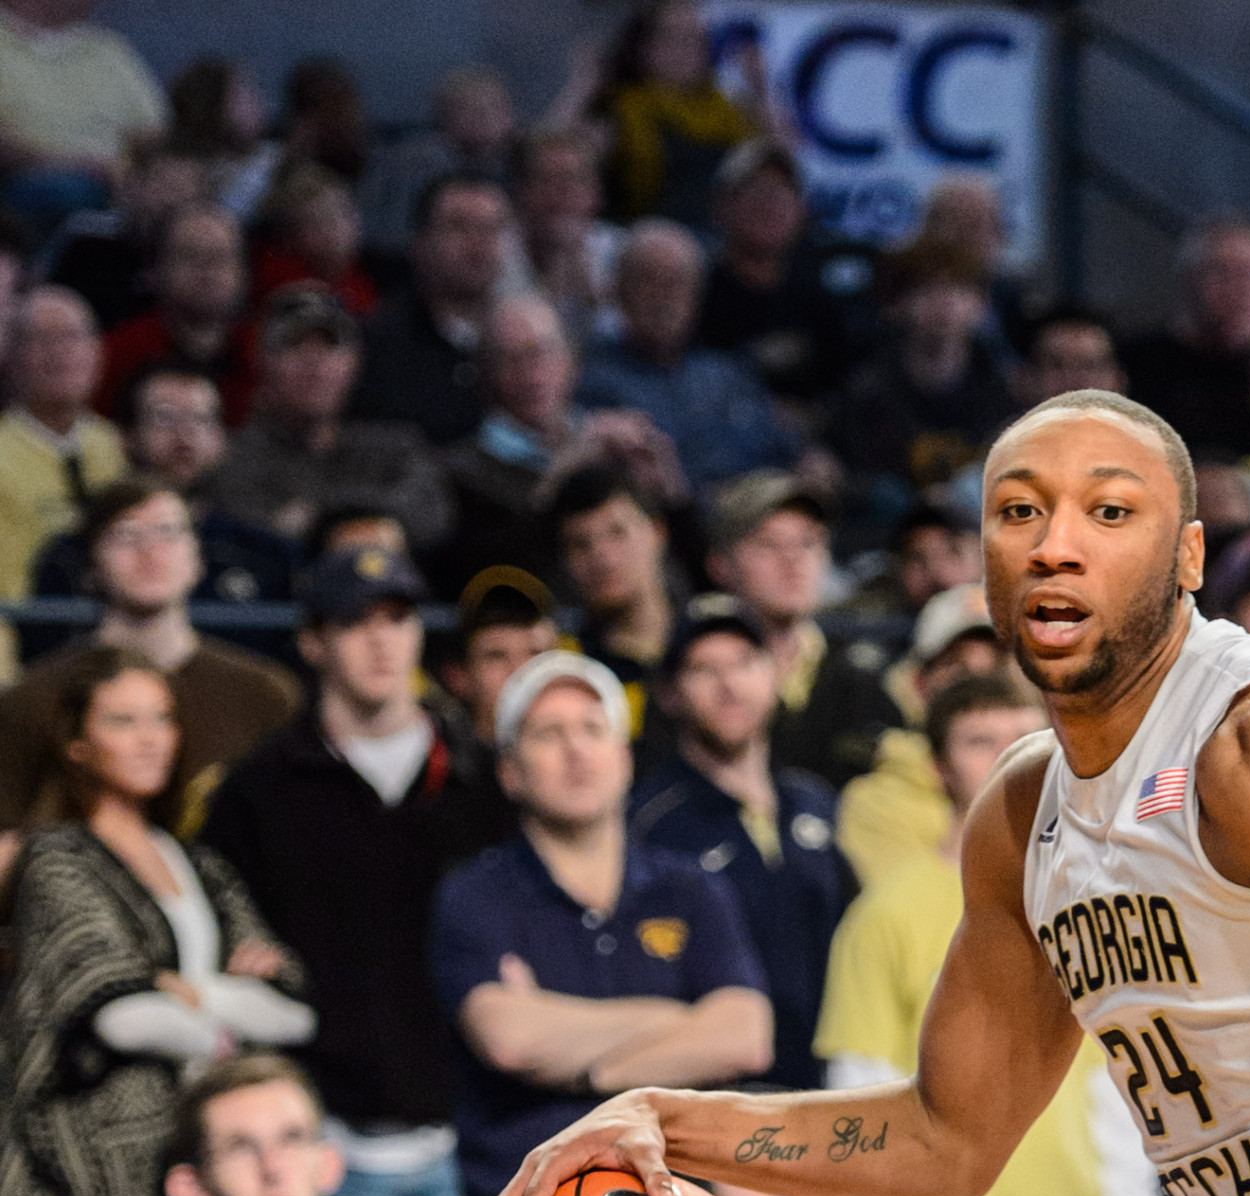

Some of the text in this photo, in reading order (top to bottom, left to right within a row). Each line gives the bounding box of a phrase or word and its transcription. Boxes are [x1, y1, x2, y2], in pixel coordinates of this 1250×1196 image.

[1098, 1016, 1213, 1136] 24
[734, 1116, 889, 1164] Fear God
